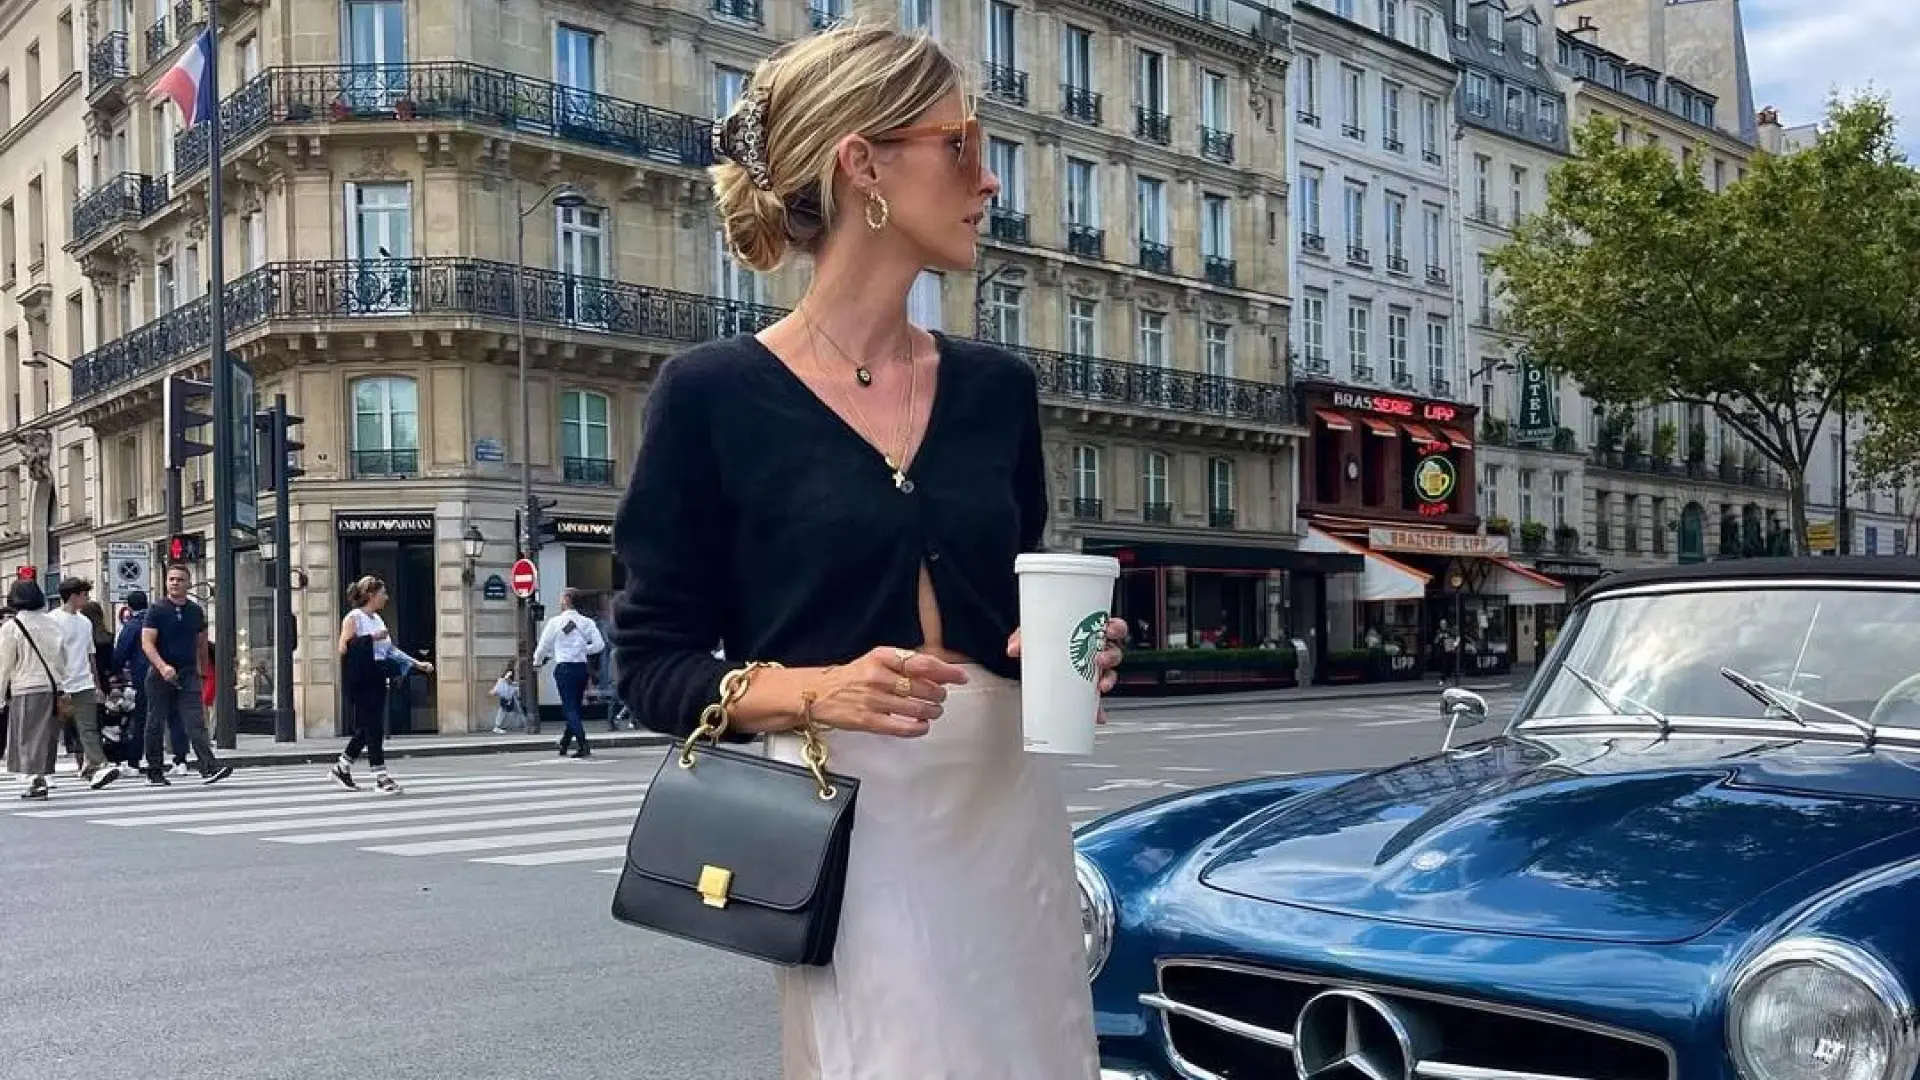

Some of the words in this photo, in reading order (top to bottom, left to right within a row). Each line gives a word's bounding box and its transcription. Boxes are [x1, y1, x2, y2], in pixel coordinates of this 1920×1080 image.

[1528, 364, 1541, 425] OTEL
[1334, 391, 1413, 416] BRASSERIE
[1424, 404, 1455, 421] LIPP
[1391, 656, 1416, 670] LIPP
[1476, 656, 1498, 669] LIPP
